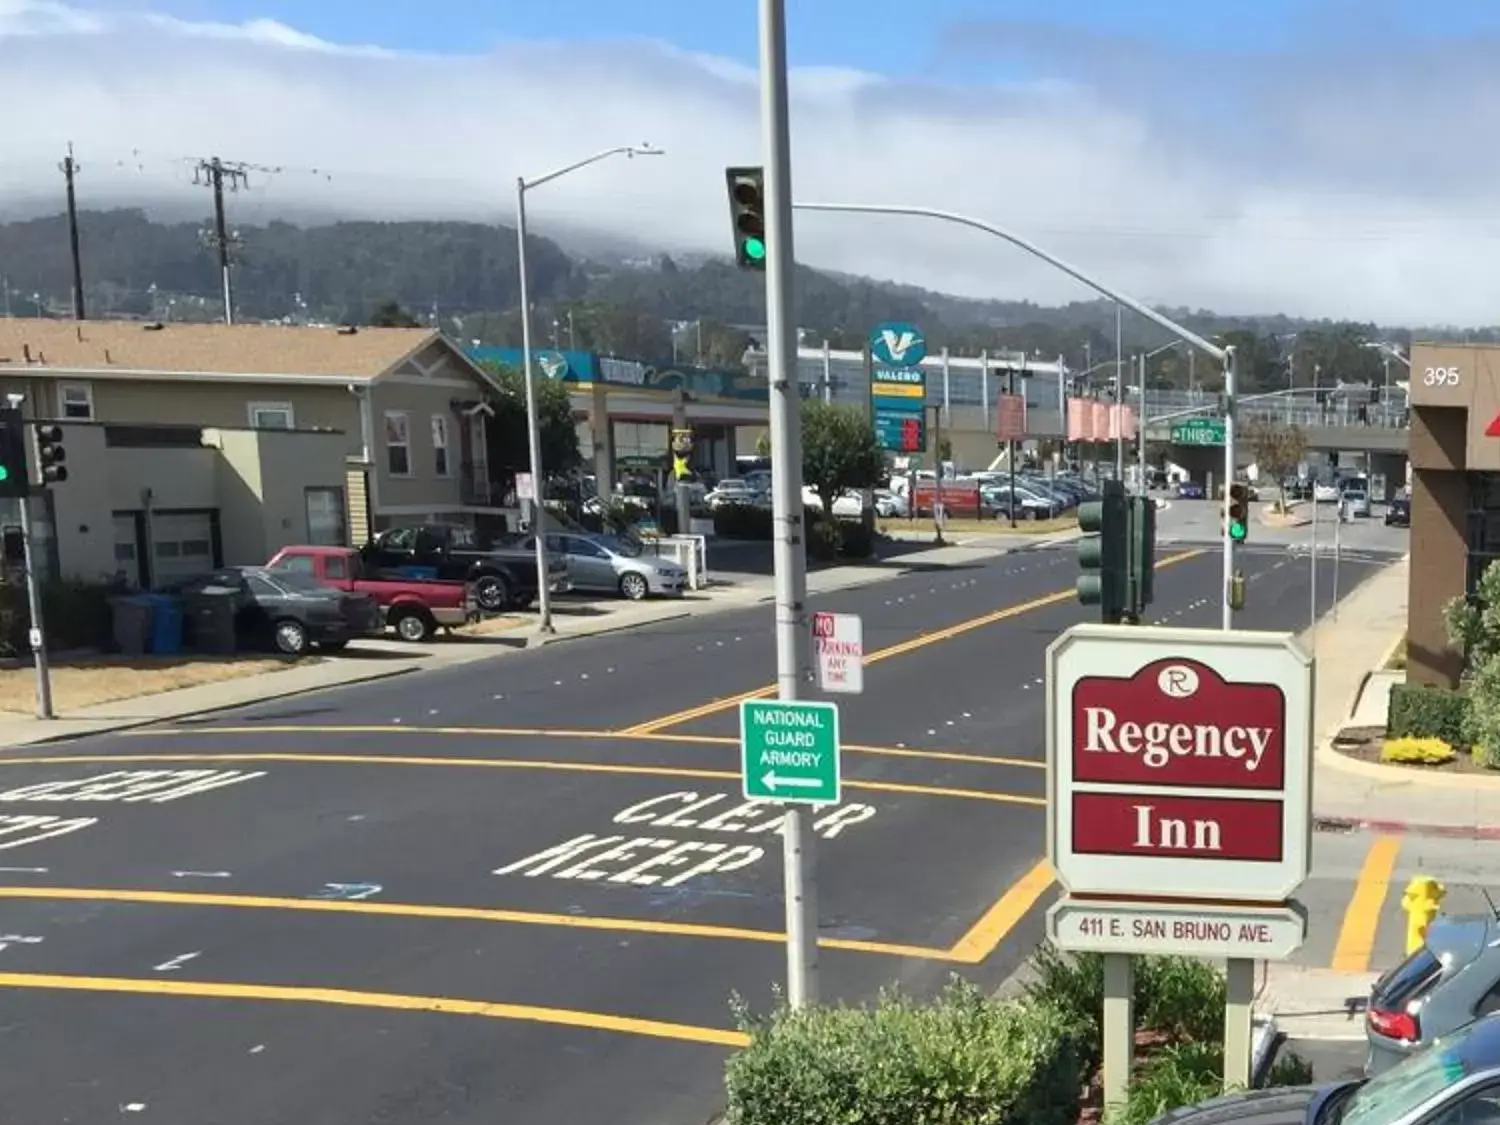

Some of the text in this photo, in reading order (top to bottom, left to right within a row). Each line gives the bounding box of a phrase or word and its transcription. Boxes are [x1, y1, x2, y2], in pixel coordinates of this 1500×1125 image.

[876, 369, 921, 381] VALERO
[1423, 367, 1459, 386] 395
[1180, 427, 1215, 442] THIRD
[815, 617, 833, 635] NO
[815, 638, 862, 657] PARKING
[1168, 671, 1190, 693] R
[753, 710, 824, 729] NATIONAL
[765, 731, 815, 747] GUARD
[1083, 706, 1273, 771] Regency
[760, 752, 822, 768] ARMORY
[1131, 804, 1222, 850] Inn
[492, 834, 765, 887] KEEP
[1079, 918, 1273, 943] 411 E. SAN BRUNO AVE.
